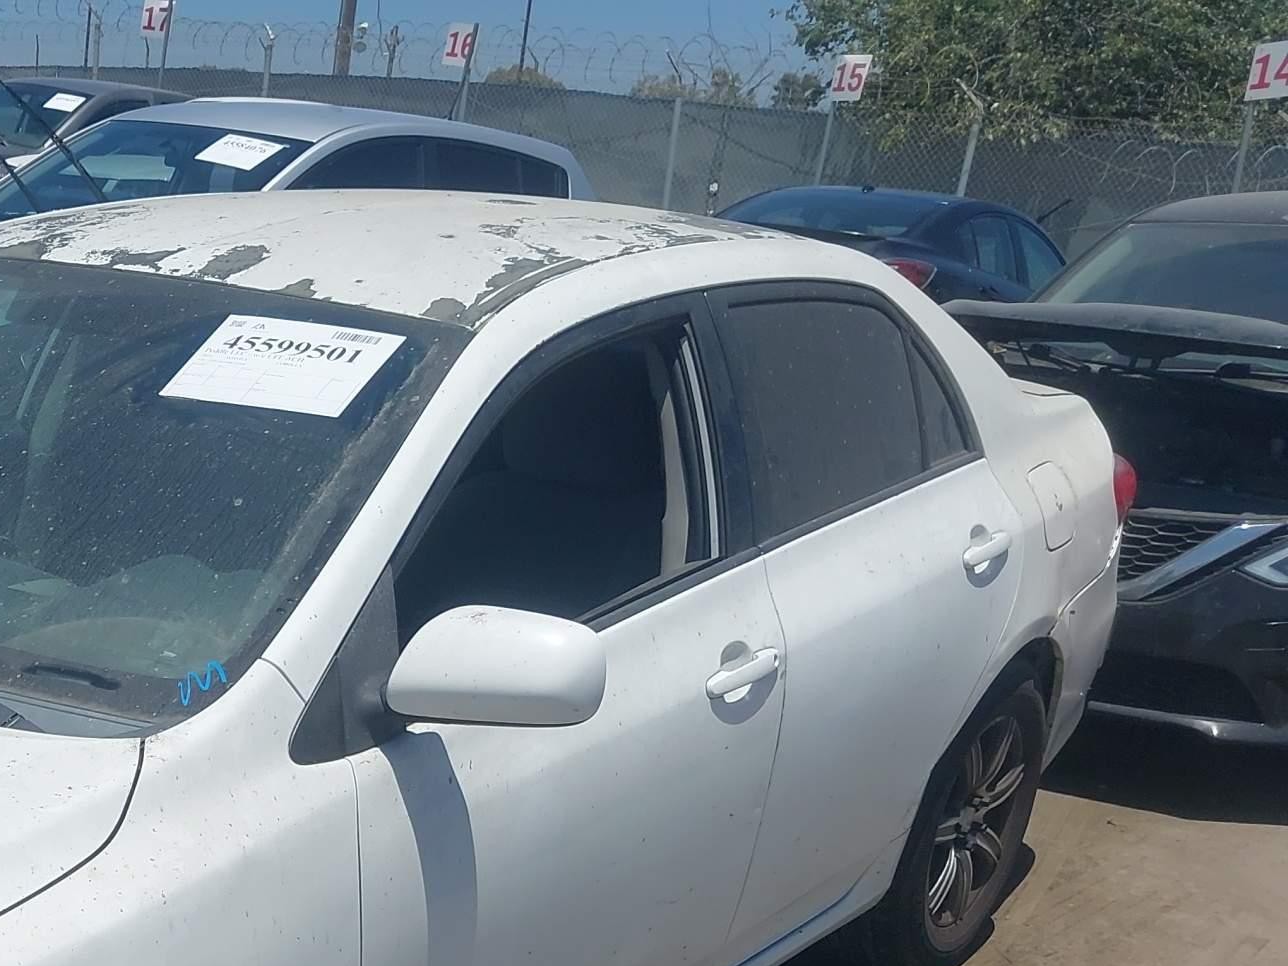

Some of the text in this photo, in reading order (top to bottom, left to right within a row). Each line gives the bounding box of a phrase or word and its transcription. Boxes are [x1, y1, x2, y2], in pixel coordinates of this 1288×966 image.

[143, 7, 170, 31] 17
[832, 64, 866, 92] 15
[223, 334, 362, 364] 45599501
